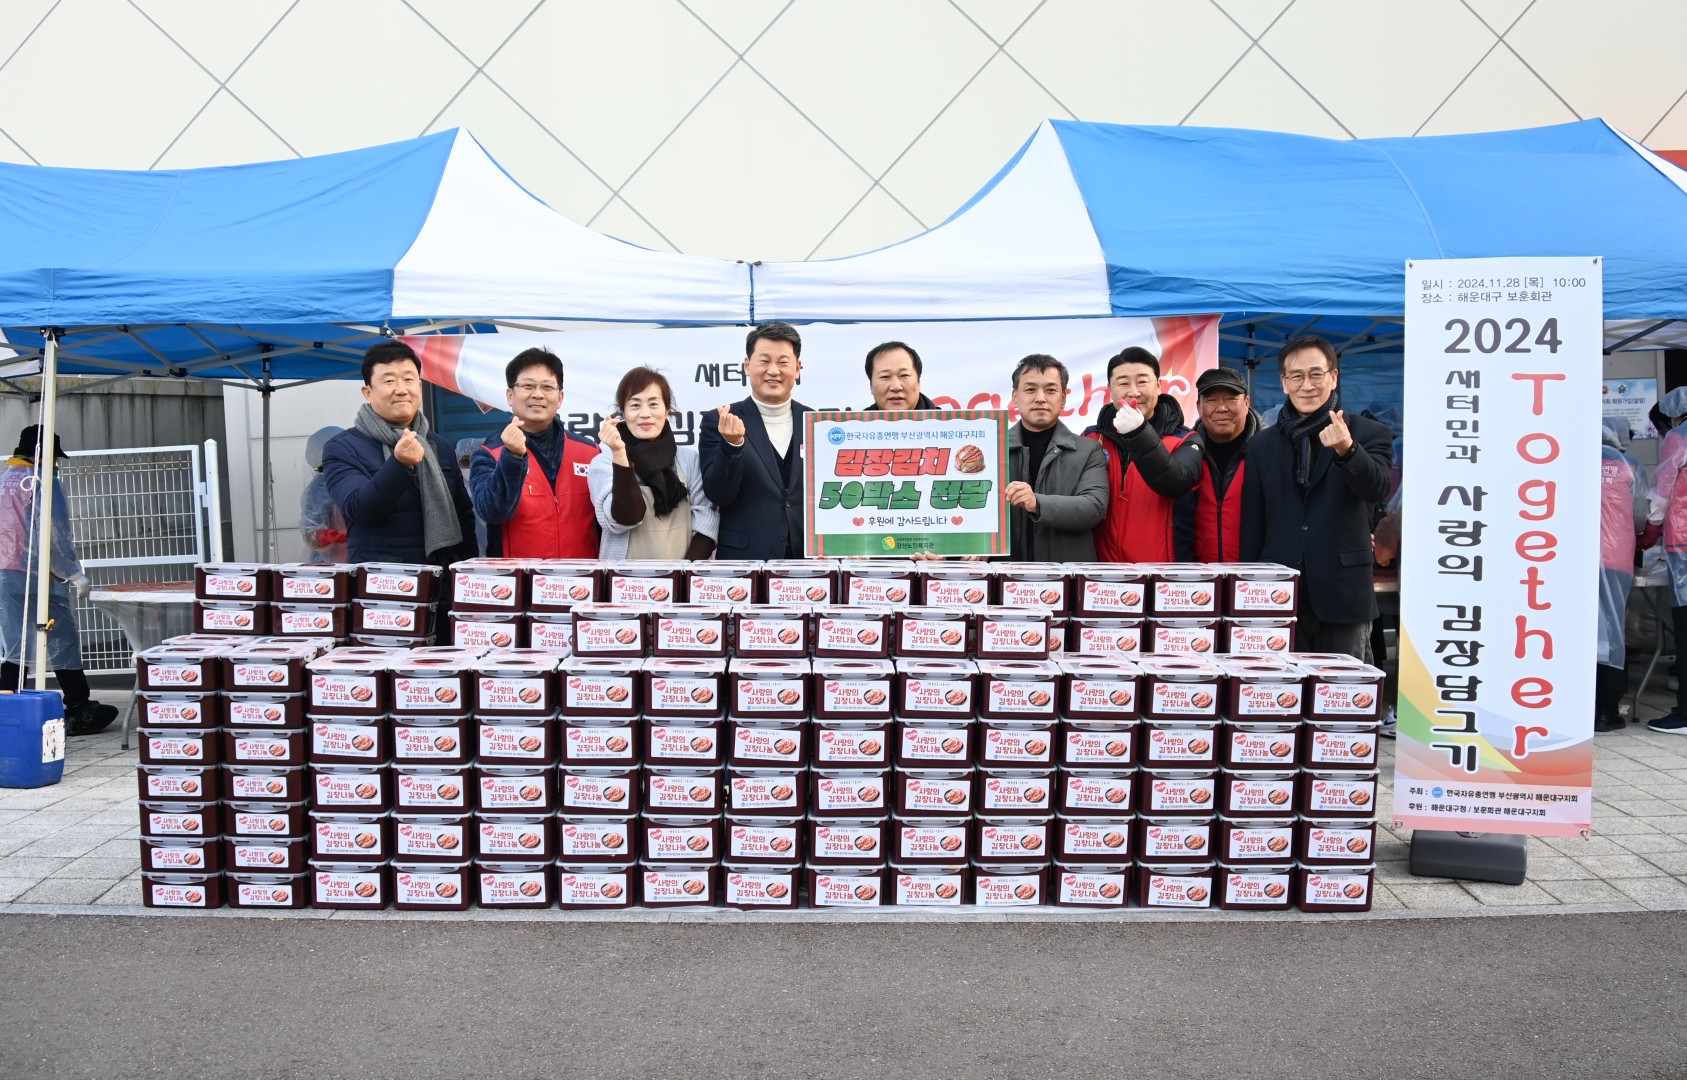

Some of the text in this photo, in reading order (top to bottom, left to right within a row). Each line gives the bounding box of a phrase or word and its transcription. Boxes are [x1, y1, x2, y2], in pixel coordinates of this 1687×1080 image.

[1421, 279, 1443, 290] 일시
[1457, 278, 1520, 289] 2024.11.28
[1524, 277, 1544, 288] [목]
[1553, 277, 1586, 288] 10:00
[1421, 293, 1443, 304] 장소
[1457, 291, 1503, 303] 해운대구
[1506, 291, 1552, 302] 보훈회관
[1444, 317, 1562, 354] 2024
[846, 430, 985, 440] 한국자유총연맹 부산광역시 해운대구지회
[834, 447, 951, 476] 김장김치
[818, 480, 992, 509] 50박스 전달
[868, 516, 947, 526] 후원에 감사드립니다
[1510, 373, 1566, 756] Together
[1432, 370, 1489, 772] 새터민과 사랑의 김장담그기
[405, 695, 434, 703] 김장나눔
[489, 695, 518, 703] 김장나눔
[661, 695, 690, 703] 김장나눔
[747, 697, 776, 705] 김장나눔
[834, 697, 862, 705] 김장나눔
[915, 697, 944, 705] 김장나눔
[659, 793, 688, 801] 김장나눔
[1409, 787, 1423, 796] 주최
[1446, 790, 1496, 799] 한국자유총연맹
[1498, 792, 1534, 801] 부산광역시
[1536, 794, 1578, 803] 해운대구지회
[1431, 804, 1466, 813] 해운대구청
[1504, 807, 1546, 816] 해운대구지회
